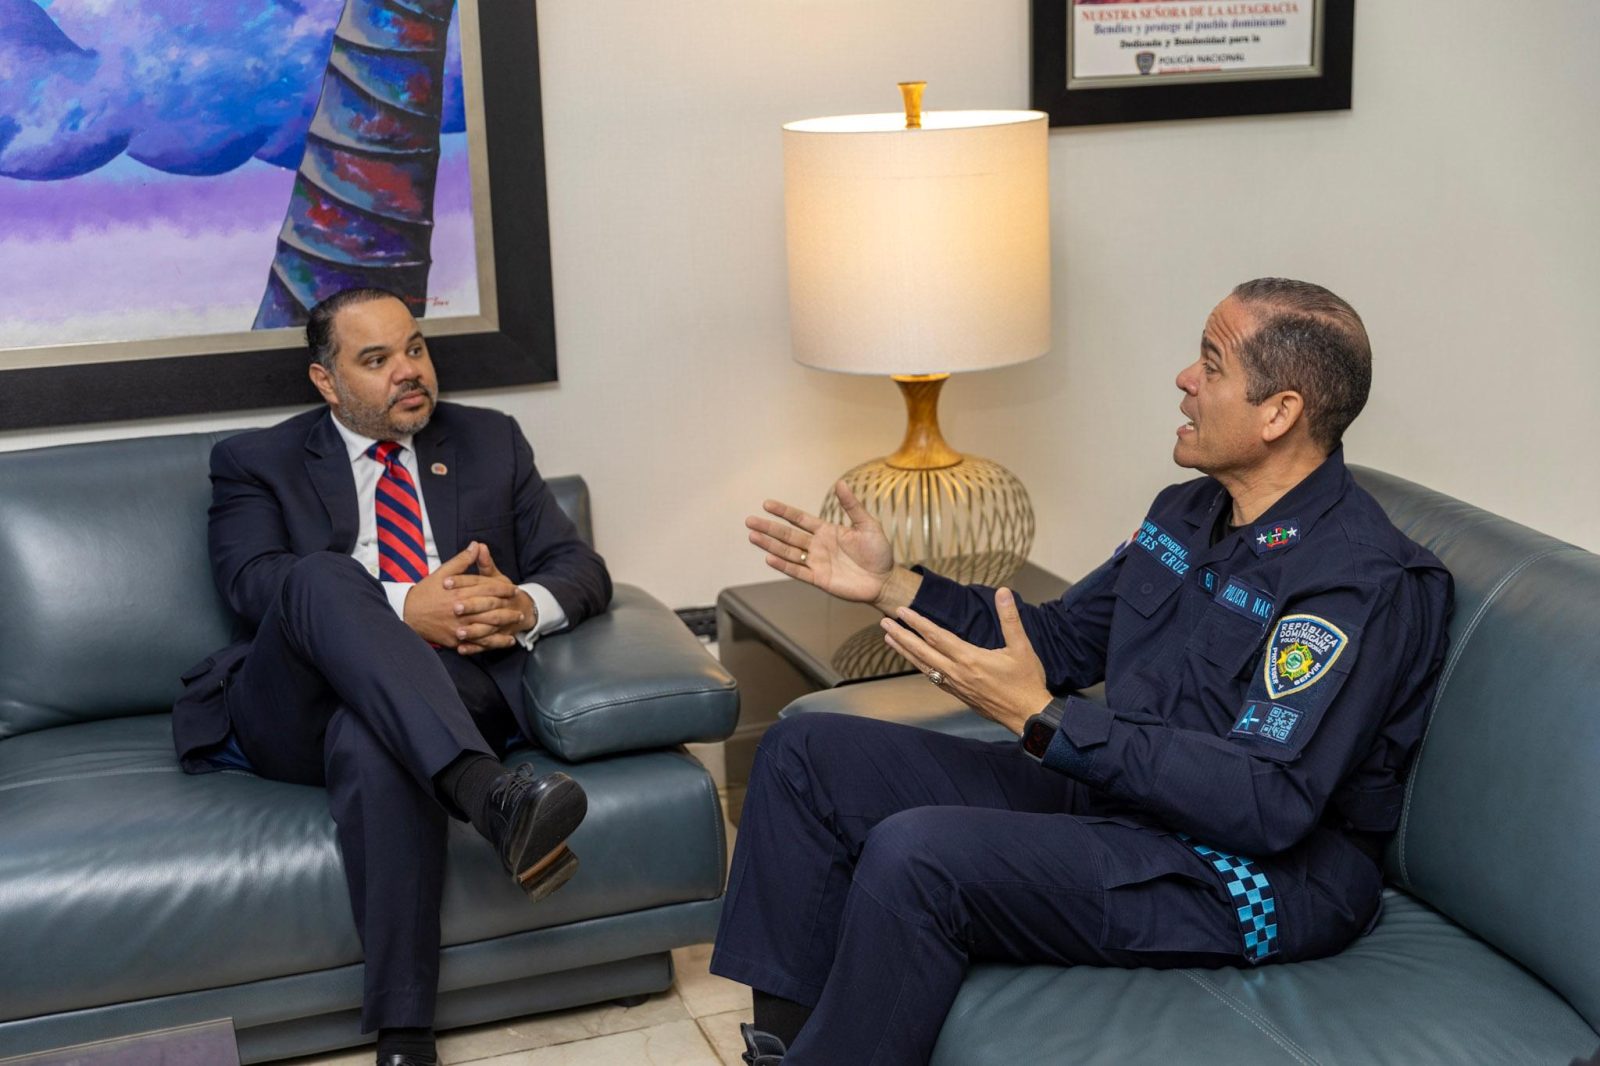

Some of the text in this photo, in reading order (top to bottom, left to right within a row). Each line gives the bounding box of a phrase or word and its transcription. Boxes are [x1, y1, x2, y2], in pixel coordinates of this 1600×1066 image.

[1082, 9, 1137, 20] NUESTRA
[1140, 6, 1187, 18] SEÑORA
[1189, 6, 1203, 16] DE
[1227, 3, 1299, 14] ALTAGRACIA
[1195, 20, 1228, 32] pueblo
[1231, 18, 1286, 28] dominicano
[1157, 533, 1189, 560] GENERAL
[1160, 551, 1190, 575] CRUZ
[1280, 630, 1330, 653] DOMINICANA
[1281, 622, 1339, 648] REPÚBLICA
